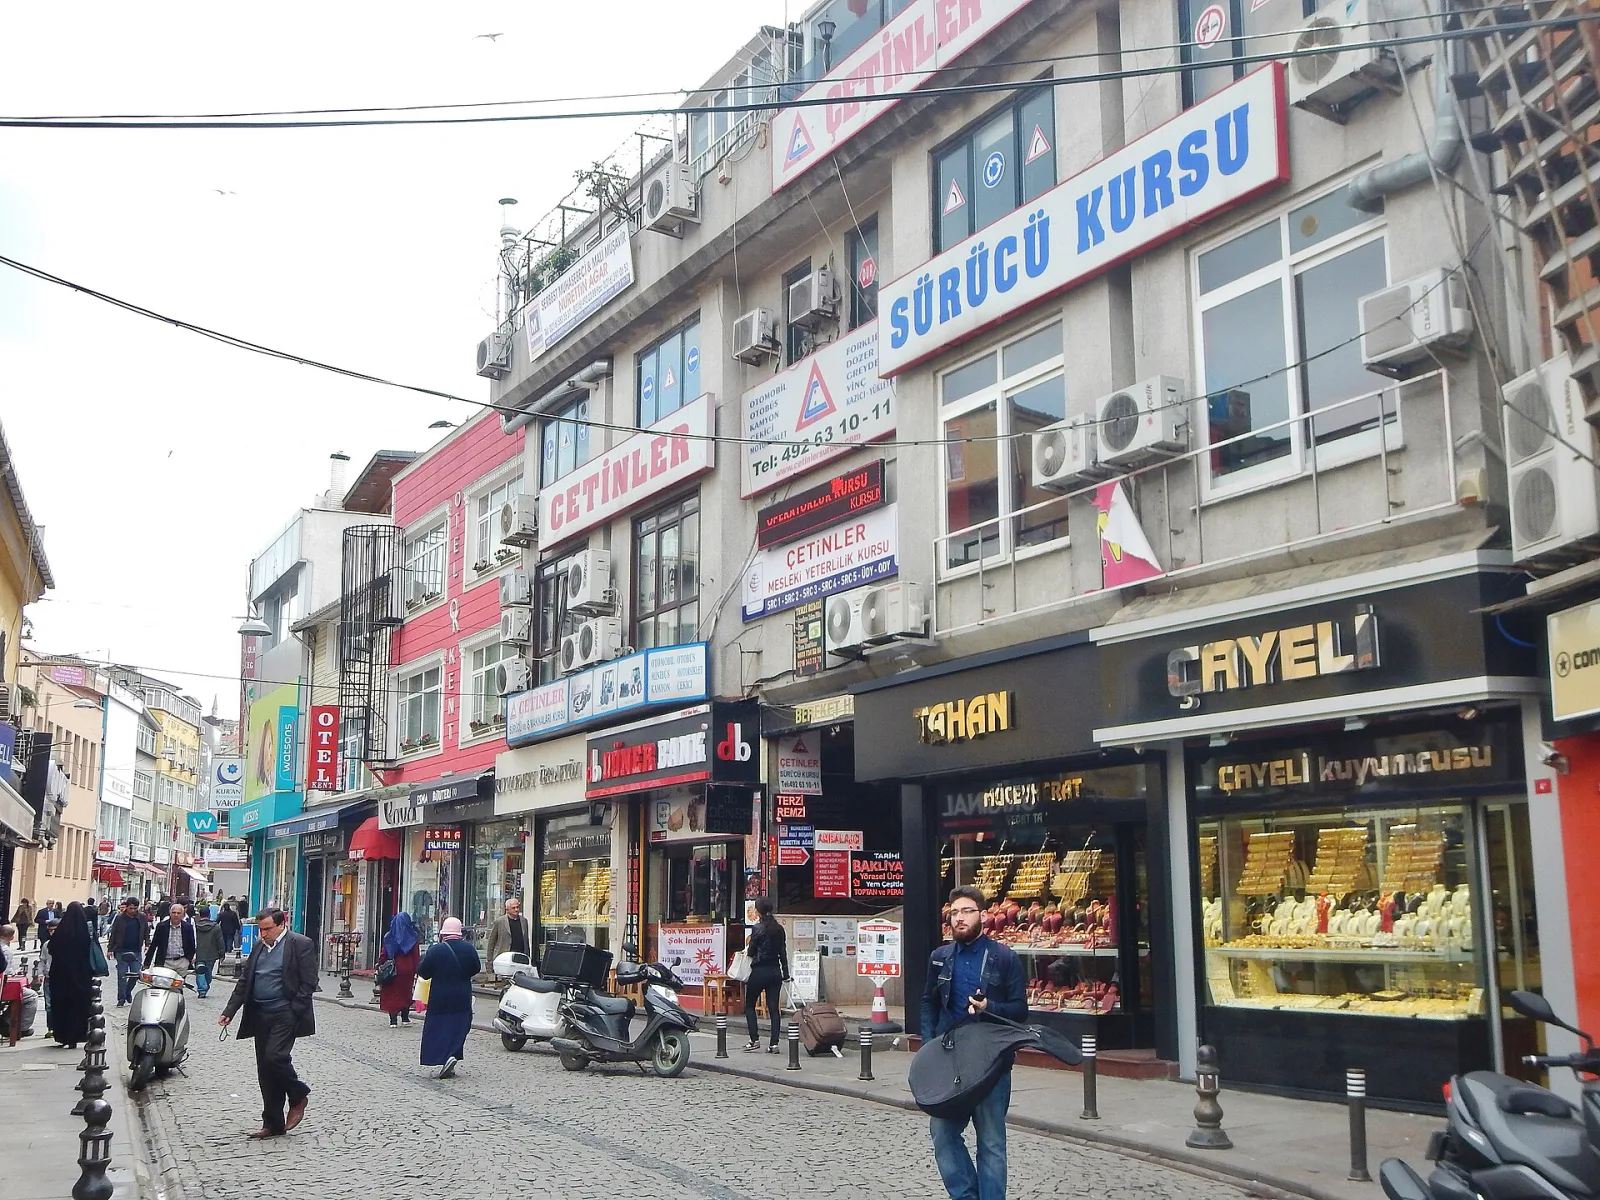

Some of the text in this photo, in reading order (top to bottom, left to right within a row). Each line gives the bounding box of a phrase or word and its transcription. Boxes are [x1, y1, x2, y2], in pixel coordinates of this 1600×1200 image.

[890, 103, 1250, 350] SÜRÜCÜ KURSU
[846, 348, 874, 368] DOZER
[846, 377, 866, 392] VİNÇ
[749, 383, 787, 408] OTOMOBİL
[749, 400, 778, 420] OTOBÜS
[749, 411, 779, 431] KAMYON
[753, 456, 778, 476] Tel:
[781, 439, 810, 462] 492
[814, 425, 833, 447] 63
[786, 523, 866, 569] ÇETİNLER
[768, 540, 890, 593] MESLEKİ YETERLİLİK KURSU
[1167, 603, 1379, 709] ÇAYELİ
[518, 688, 565, 716] ÇETİNLER
[913, 690, 1009, 744] TAHAN
[283, 723, 293, 773] watsons
[316, 712, 334, 782] OTEL
[717, 722, 752, 762] db
[780, 758, 819, 768] ÇETİNLER
[1218, 745, 1492, 796] ÇAYELİ kuyumcusu
[311, 781, 333, 789] KENT
[802, 771, 820, 779] KURSU
[776, 795, 804, 806] TERZİ
[777, 806, 806, 818] REMZİ
[426, 831, 461, 840] ESMA
[854, 888, 877, 896] TOPTAN
[668, 935, 713, 945] Şok İndirim
[678, 928, 720, 936] Kampanya
